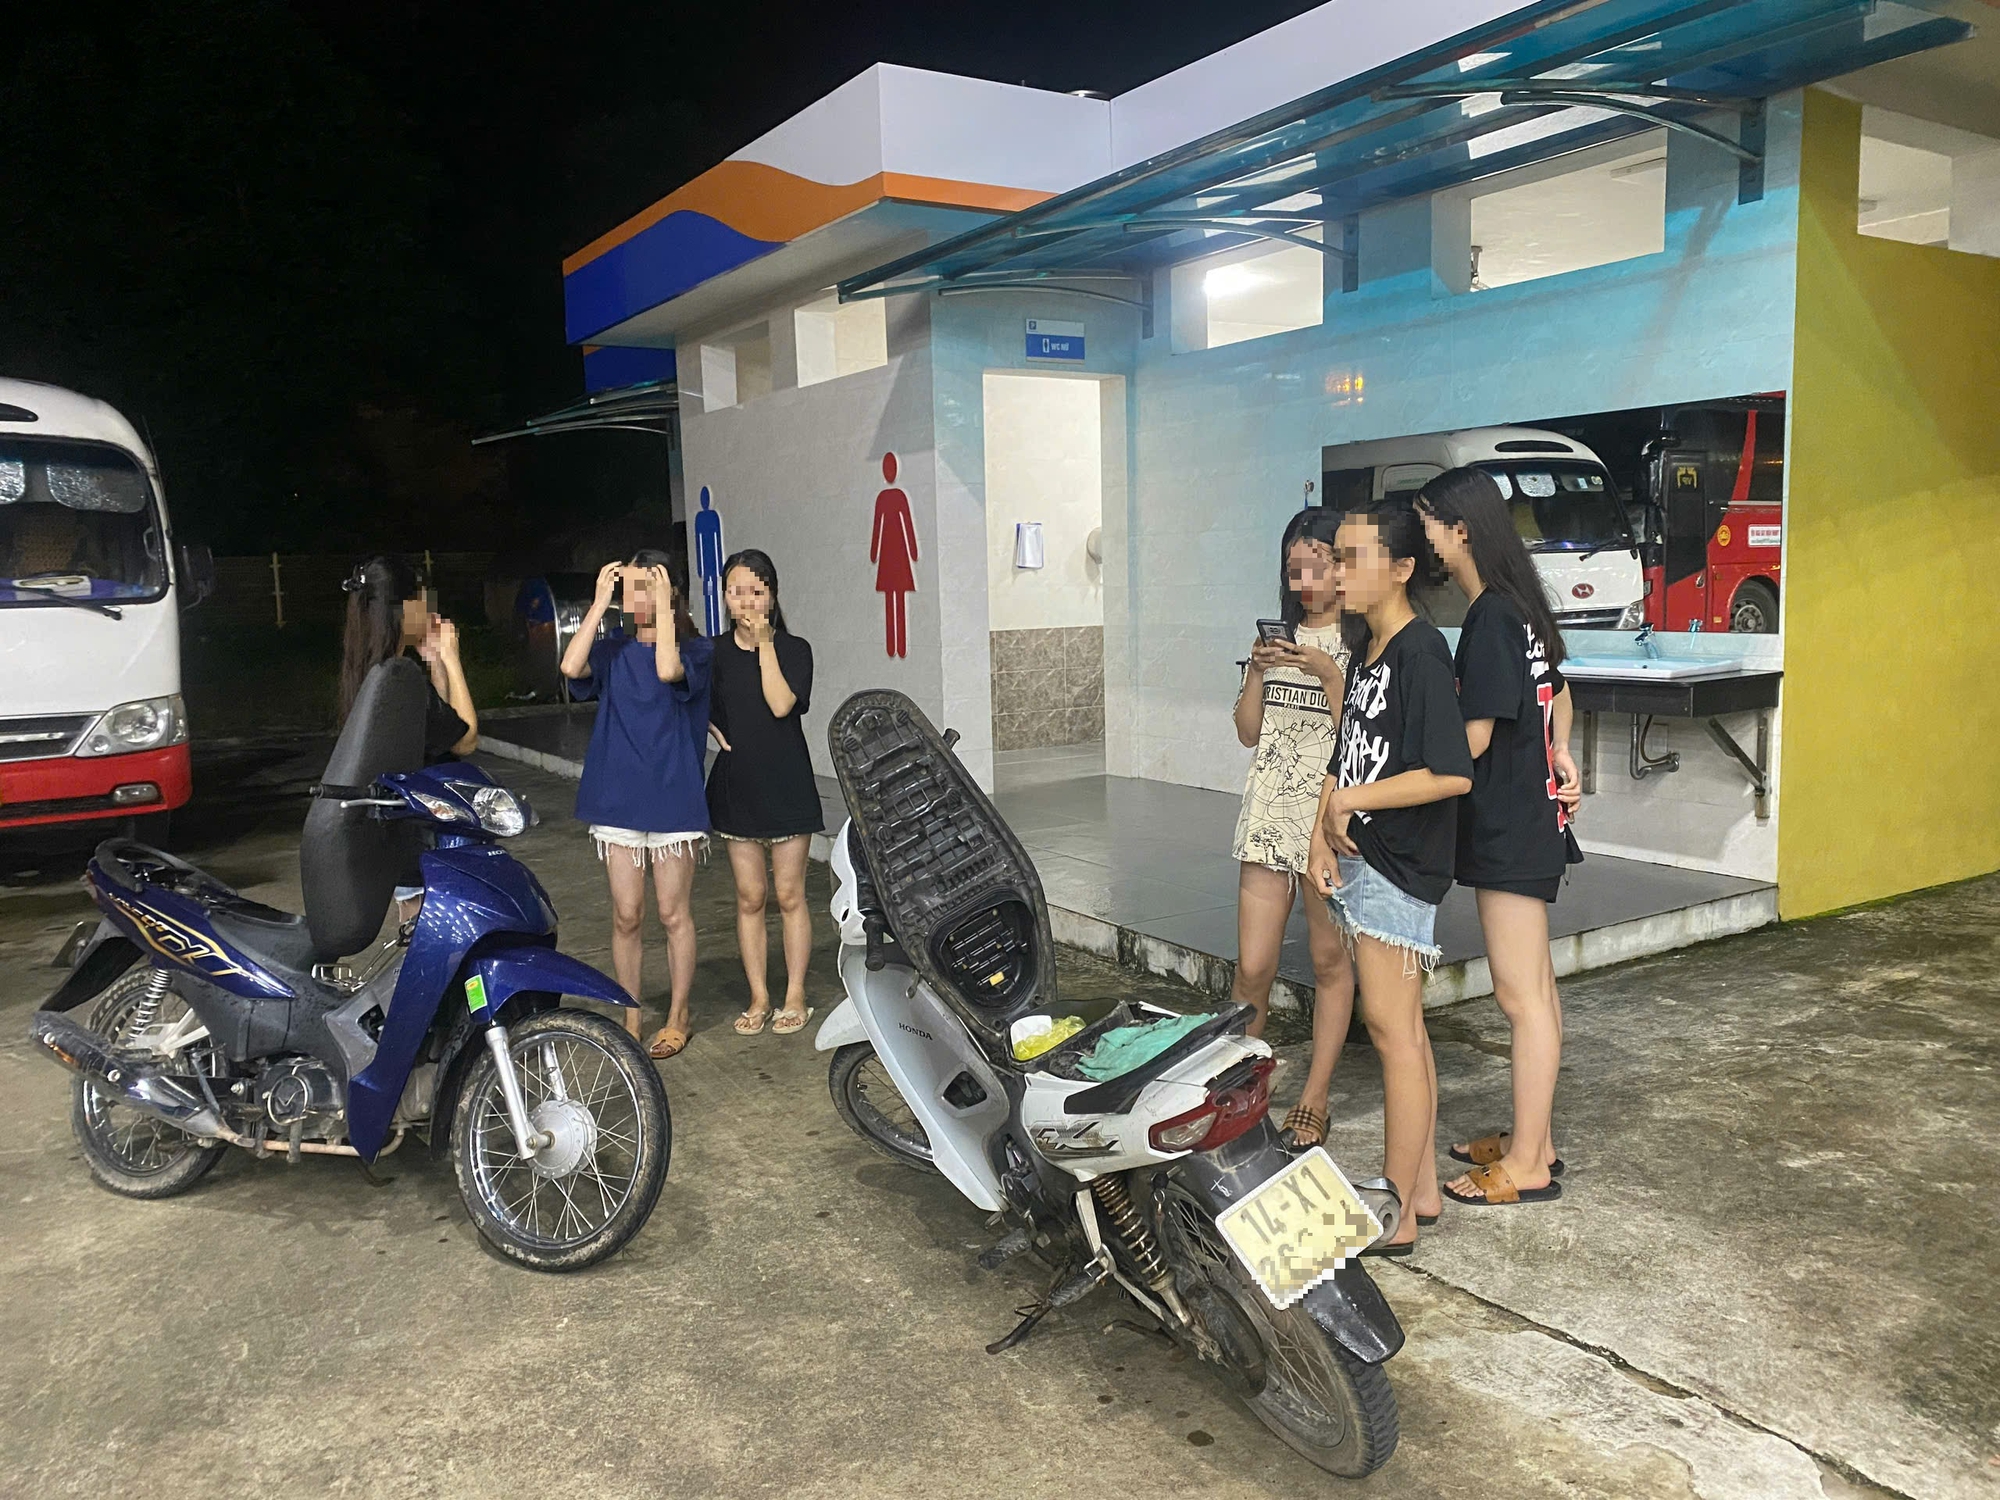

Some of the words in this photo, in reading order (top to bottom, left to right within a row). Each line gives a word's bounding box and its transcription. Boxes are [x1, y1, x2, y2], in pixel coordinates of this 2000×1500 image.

[1310, 692, 1328, 707] DIO
[899, 1023, 932, 1040] HONDA
[1241, 1165, 1331, 1244] 14-X1
